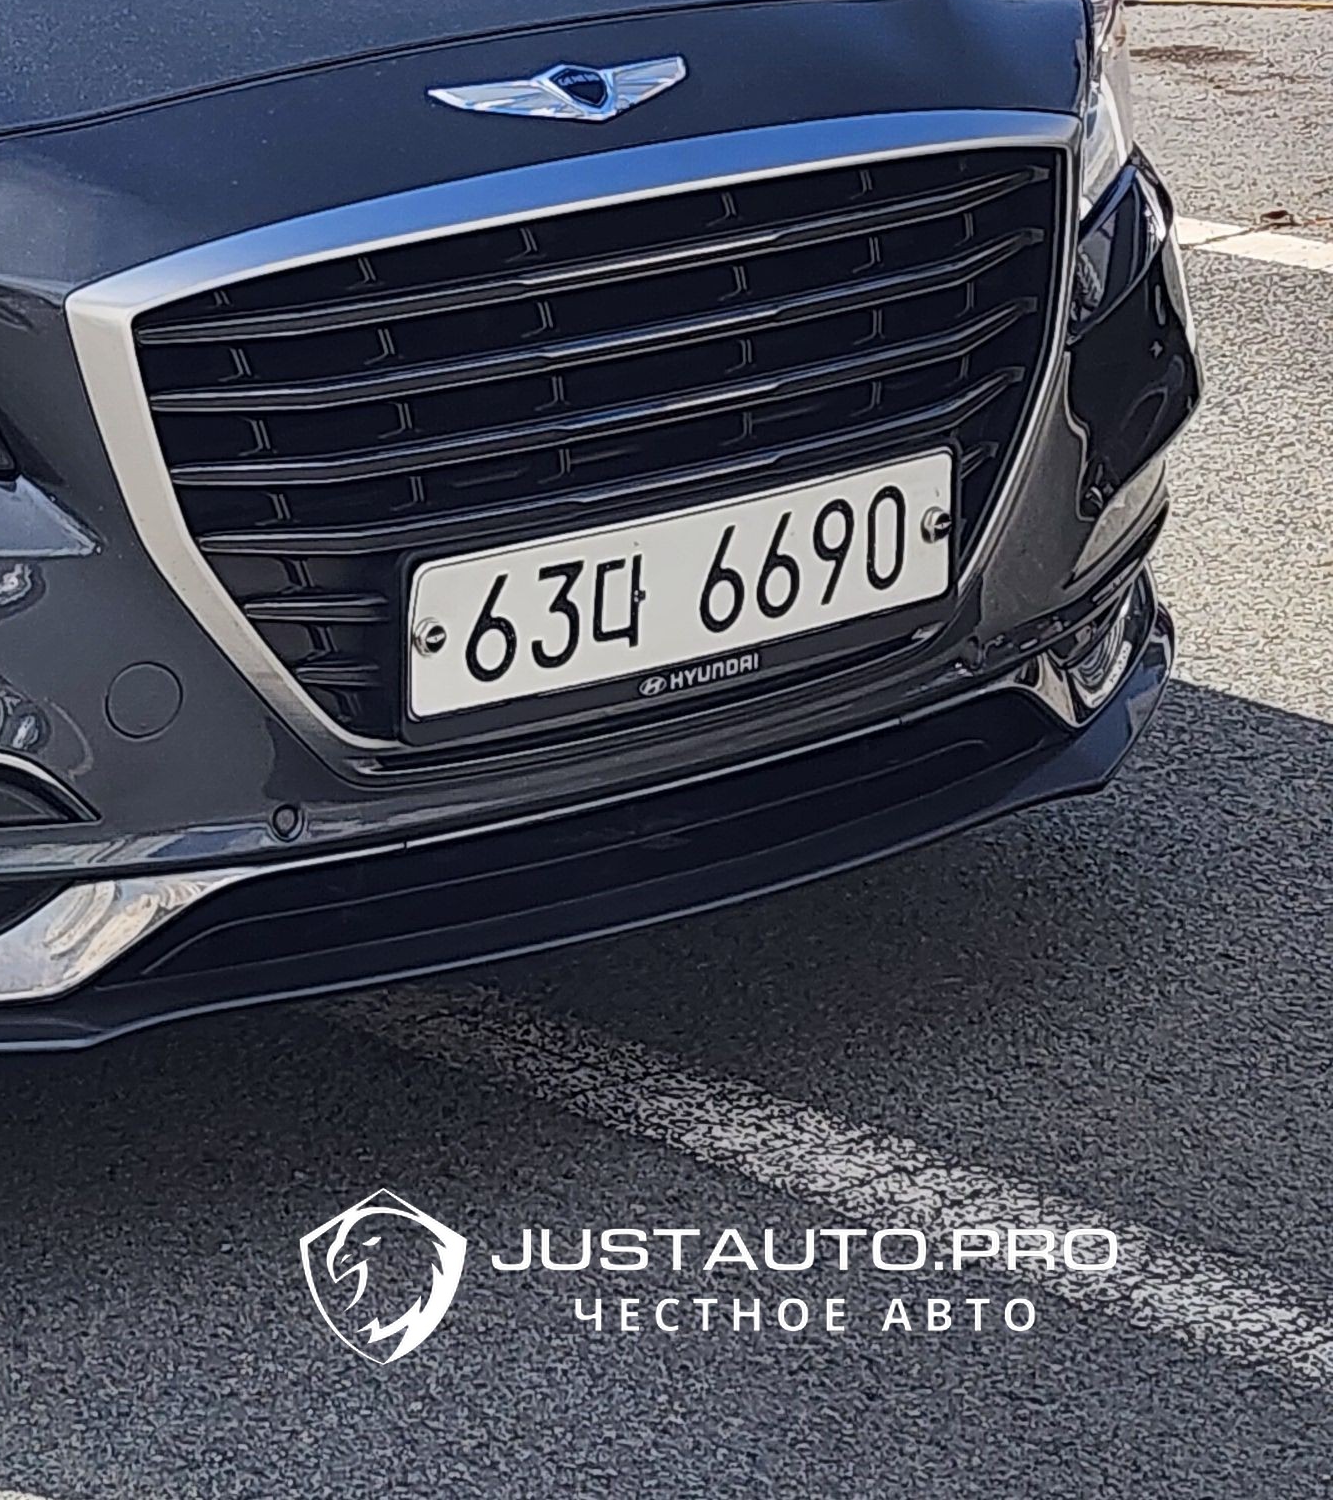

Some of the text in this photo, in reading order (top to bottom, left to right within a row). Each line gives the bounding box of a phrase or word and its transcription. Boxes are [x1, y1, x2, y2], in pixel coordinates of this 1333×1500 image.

[464, 484, 907, 683] 63다 6690
[668, 652, 760, 691] HYUNDAI
